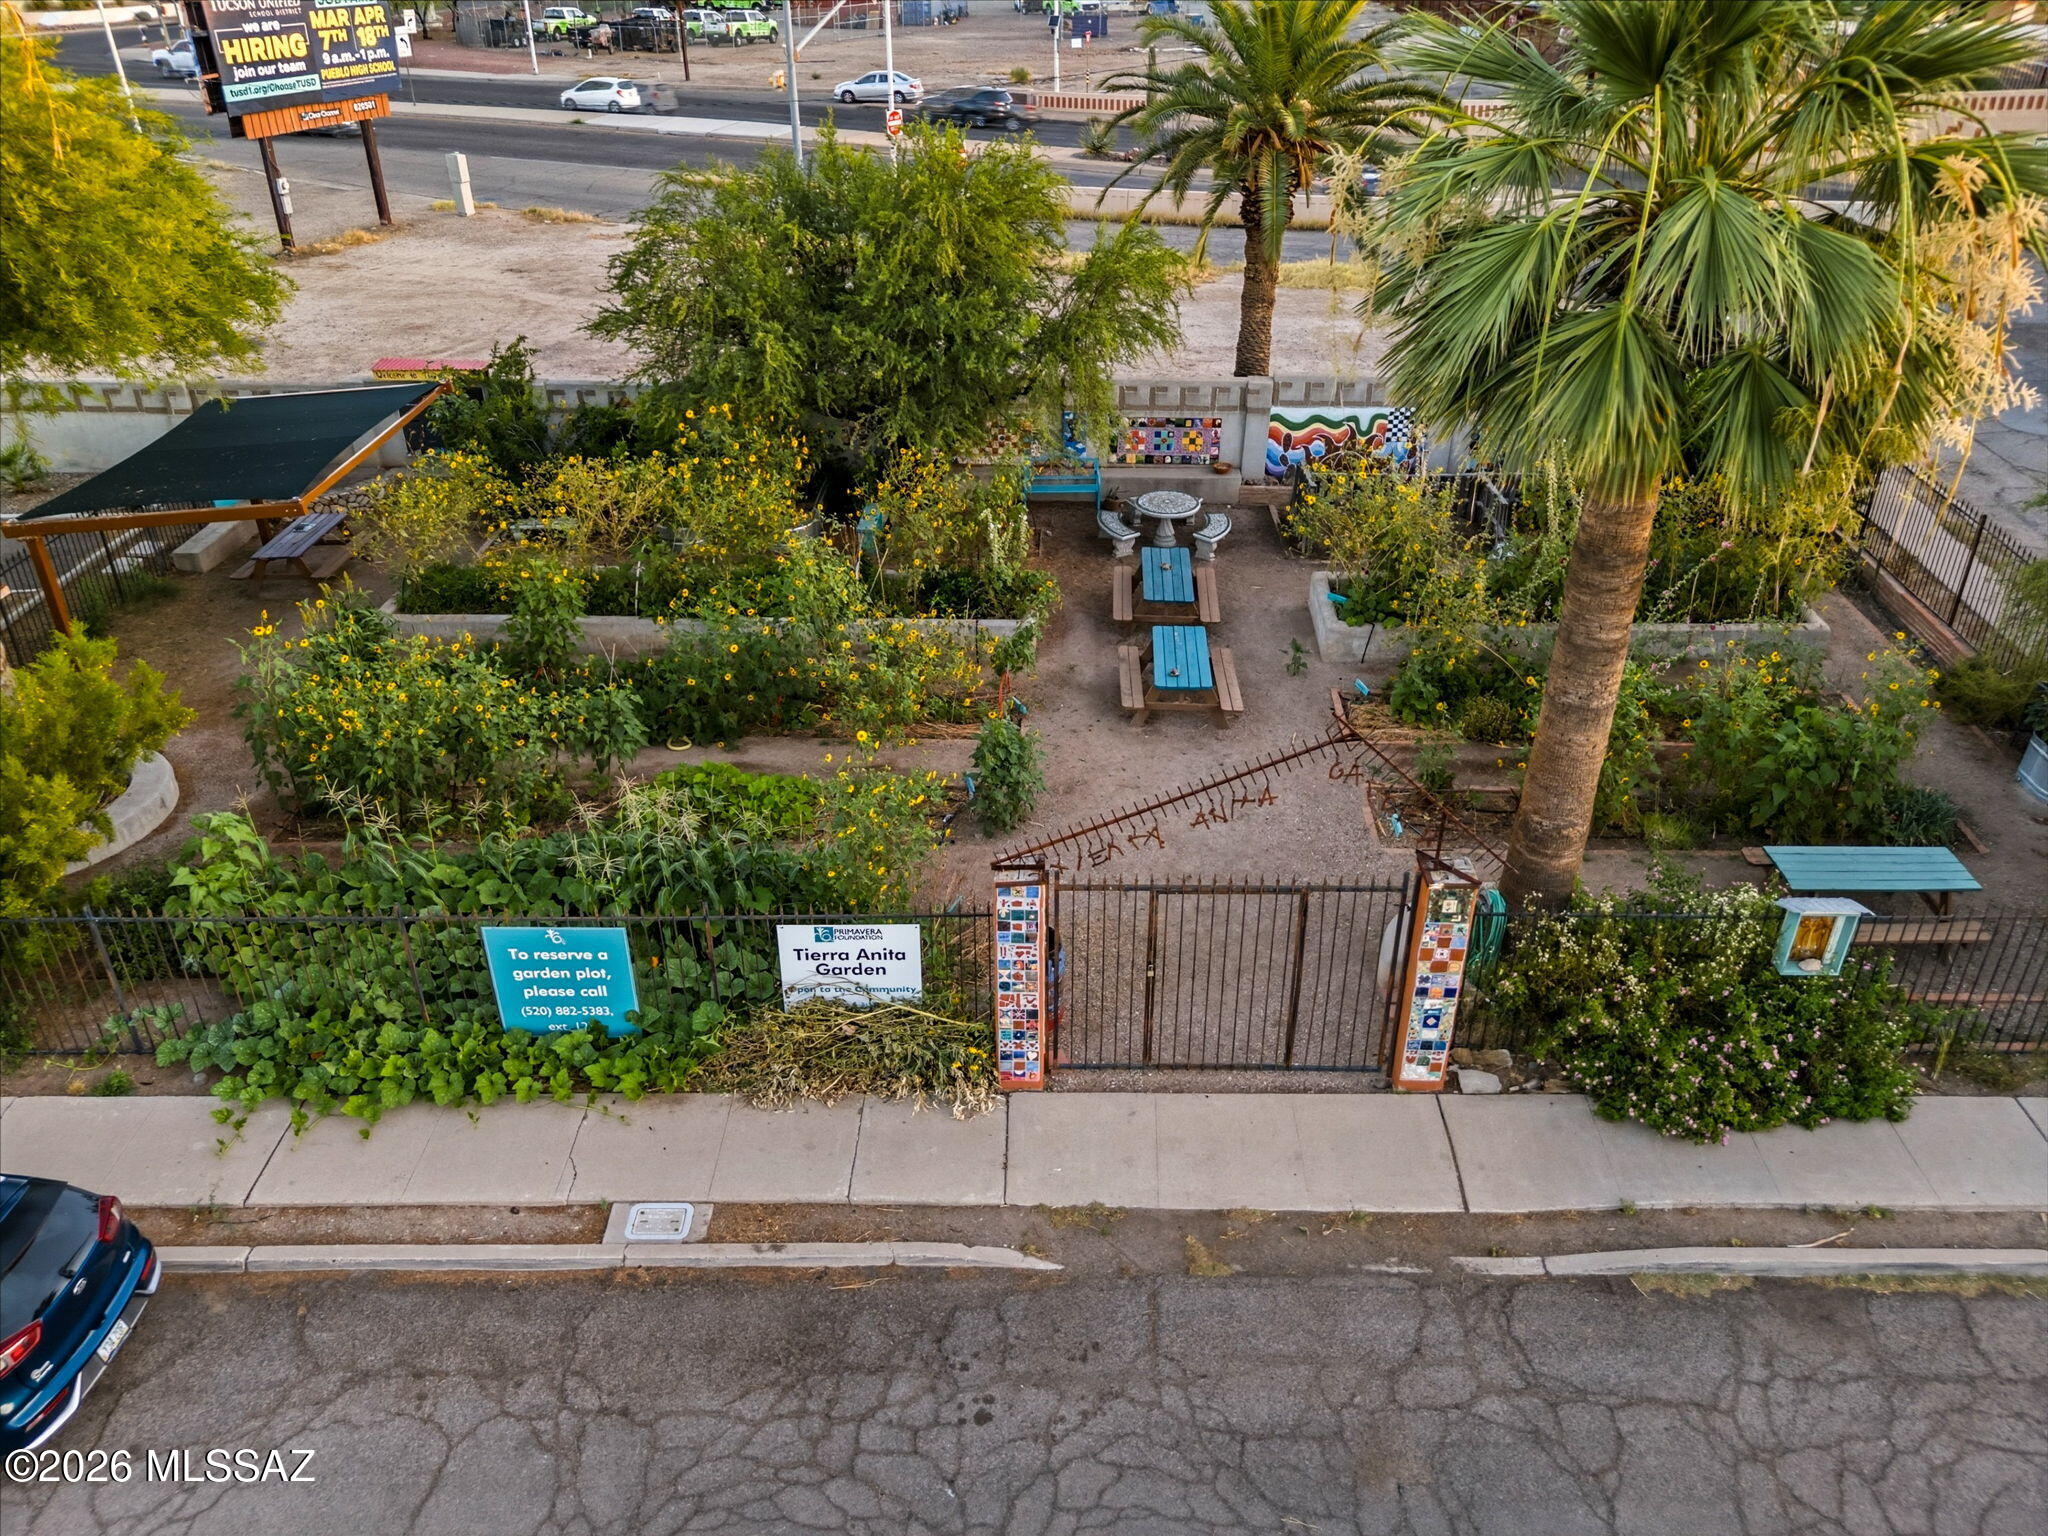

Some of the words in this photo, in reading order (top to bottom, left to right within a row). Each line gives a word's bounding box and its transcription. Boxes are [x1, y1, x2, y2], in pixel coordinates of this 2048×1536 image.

[211, 0, 255, 12] TUCSON
[309, 8, 350, 29] MAR
[354, 5, 387, 26] APR
[241, 21, 260, 33] we
[261, 20, 281, 31] are
[318, 28, 348, 51] 7TH
[356, 24, 390, 47] 18TH
[221, 32, 308, 64] HIRING
[233, 64, 257, 82] join
[257, 64, 277, 76] our
[277, 61, 307, 74] team
[320, 66, 350, 80] PUEBLO
[350, 63, 369, 77] HIGH
[369, 60, 396, 74] SCHOOL
[834, 928, 882, 936] PRIMAVERA
[507, 948, 529, 961] To
[533, 950, 593, 961] reserve
[597, 950, 608, 961] a
[793, 948, 849, 961] Tierra
[856, 948, 906, 961] Anita
[512, 967, 571, 981] garden
[576, 967, 612, 981] plot,
[816, 963, 886, 976] Garden
[523, 985, 576, 999] please
[580, 985, 608, 998] call
[521, 1006, 551, 1018] (520)
